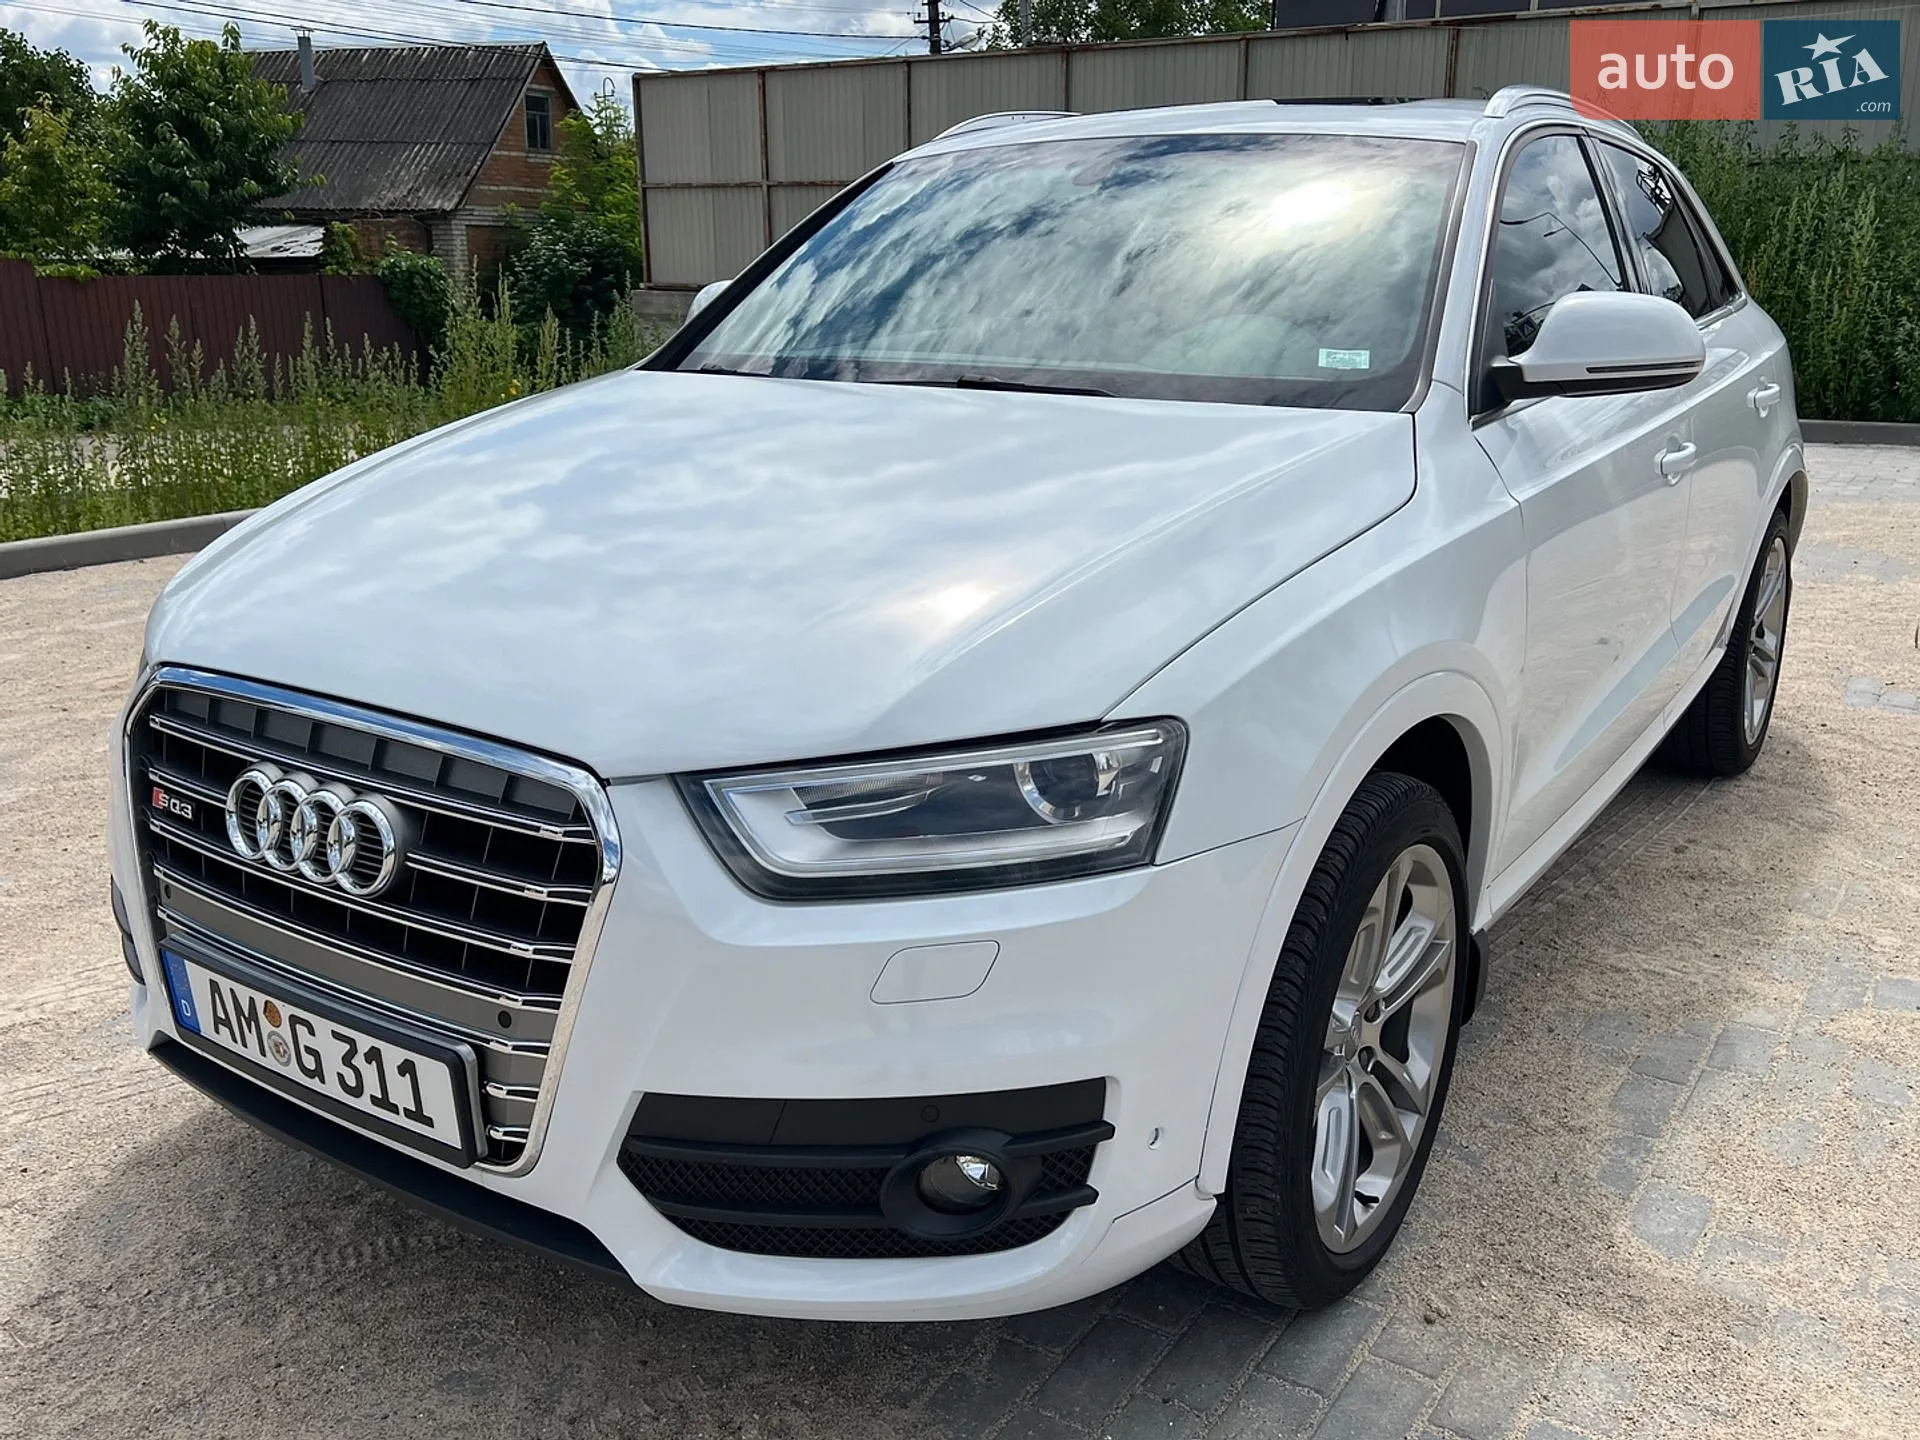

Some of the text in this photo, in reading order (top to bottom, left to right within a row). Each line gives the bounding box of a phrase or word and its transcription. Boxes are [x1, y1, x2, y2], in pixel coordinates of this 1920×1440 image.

[153, 787, 193, 819] SQ3
[209, 978, 266, 1057] AM
[331, 1030, 434, 1128] 311
